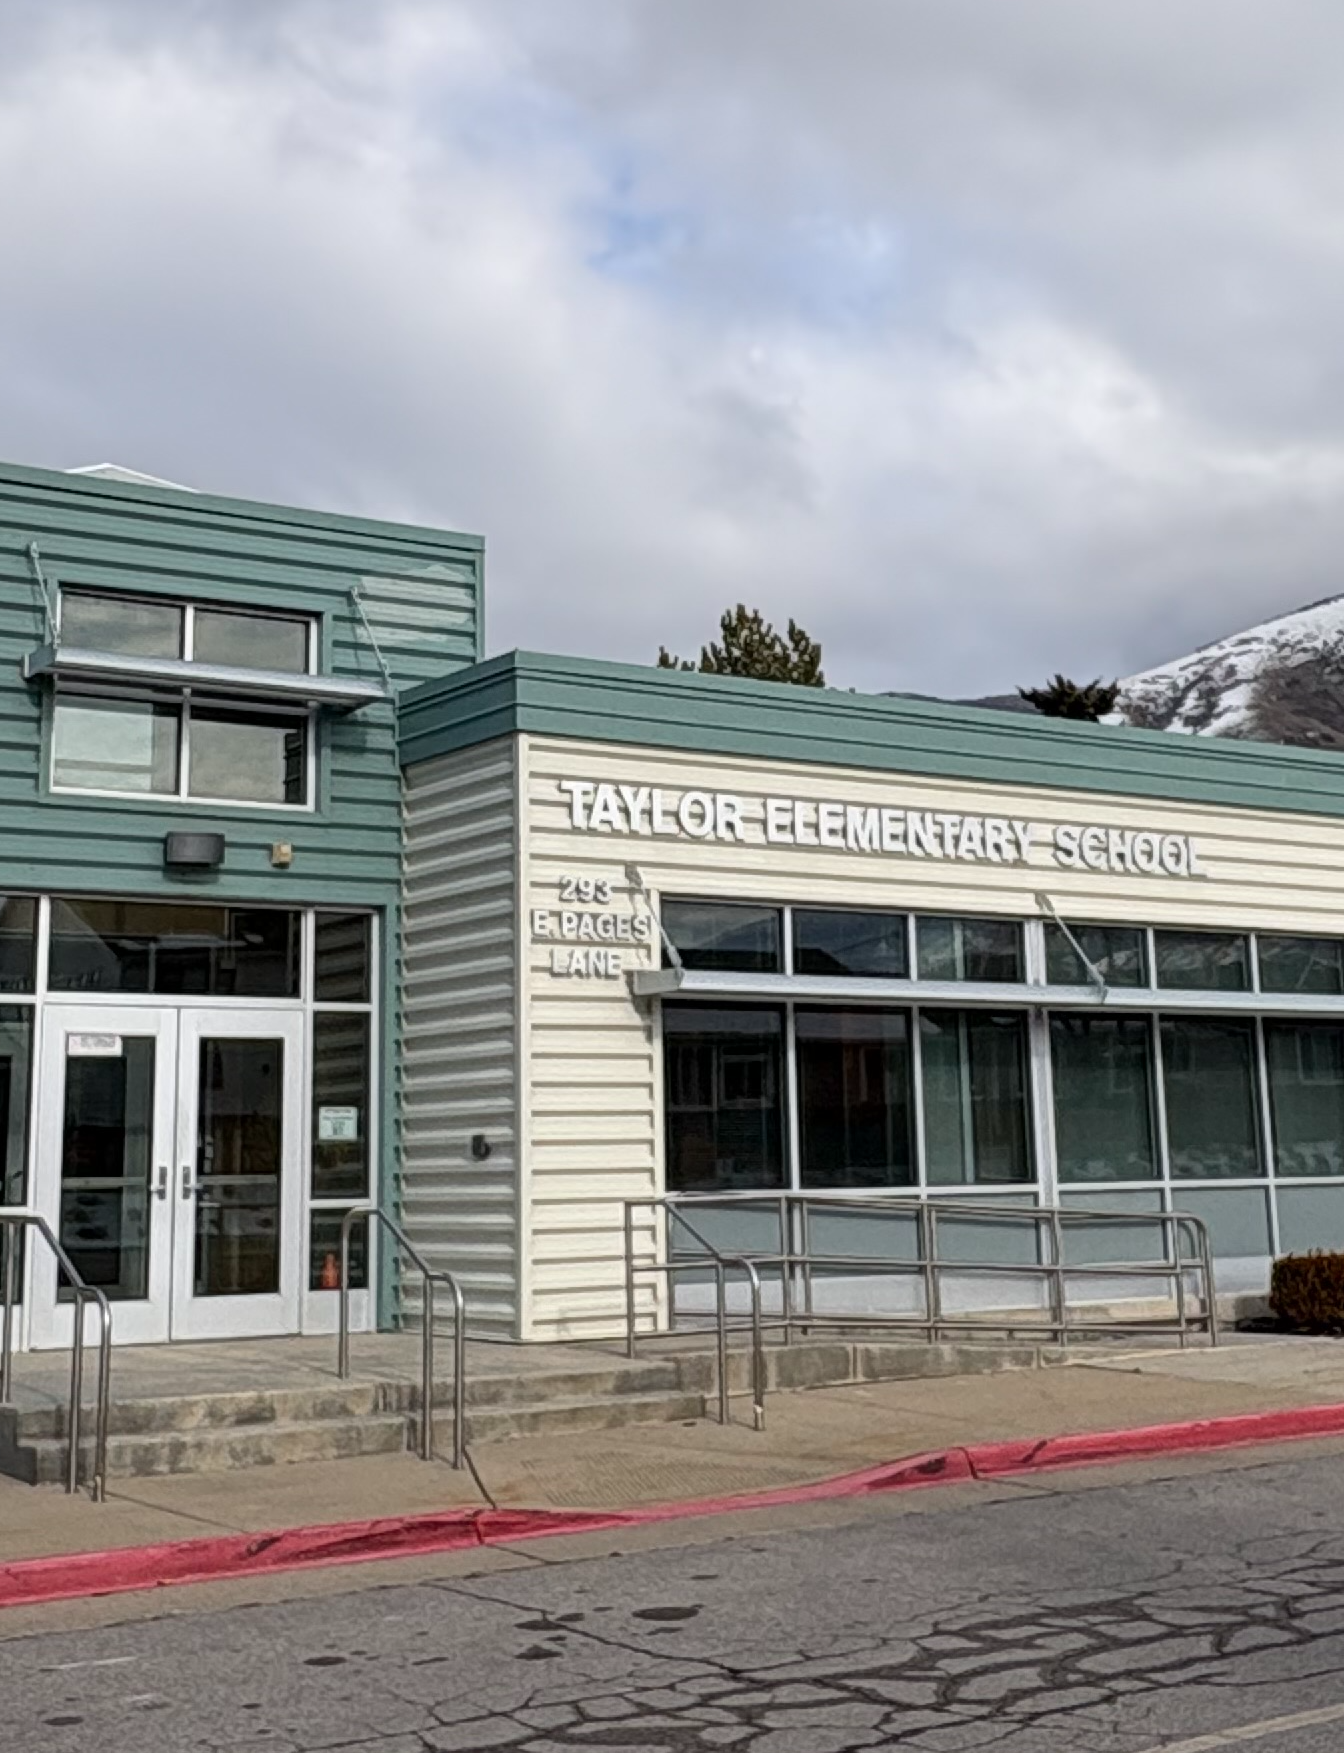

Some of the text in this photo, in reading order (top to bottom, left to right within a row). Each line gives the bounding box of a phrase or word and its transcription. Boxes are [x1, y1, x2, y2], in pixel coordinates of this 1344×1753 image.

[560, 780, 1209, 878] TAYLOR ELEMENTARY SCHOOL
[559, 877, 612, 904] 293
[560, 911, 649, 941] PAGES
[550, 948, 622, 979] LANE
